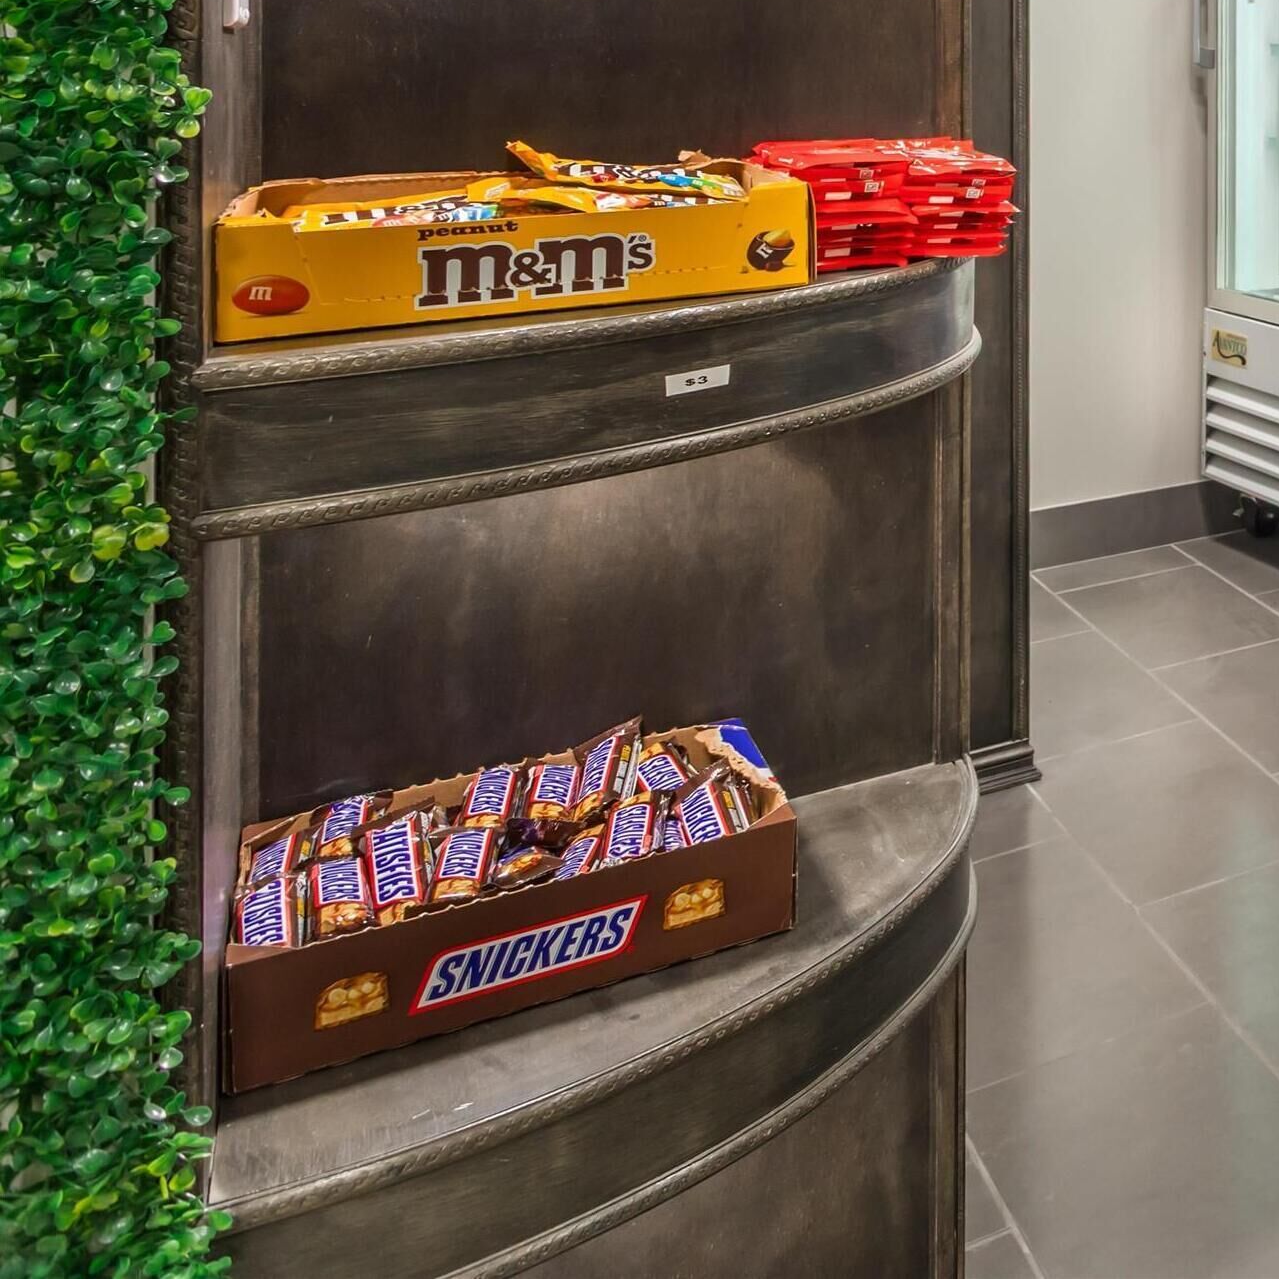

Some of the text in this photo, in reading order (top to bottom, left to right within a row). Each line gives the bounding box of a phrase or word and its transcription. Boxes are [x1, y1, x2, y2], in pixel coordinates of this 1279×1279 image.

[416, 220, 519, 242] peanut
[248, 284, 273, 302] m
[417, 233, 654, 309] m&m's
[442, 828, 488, 878] NICKERS
[428, 907, 634, 1001] SNICKERS
